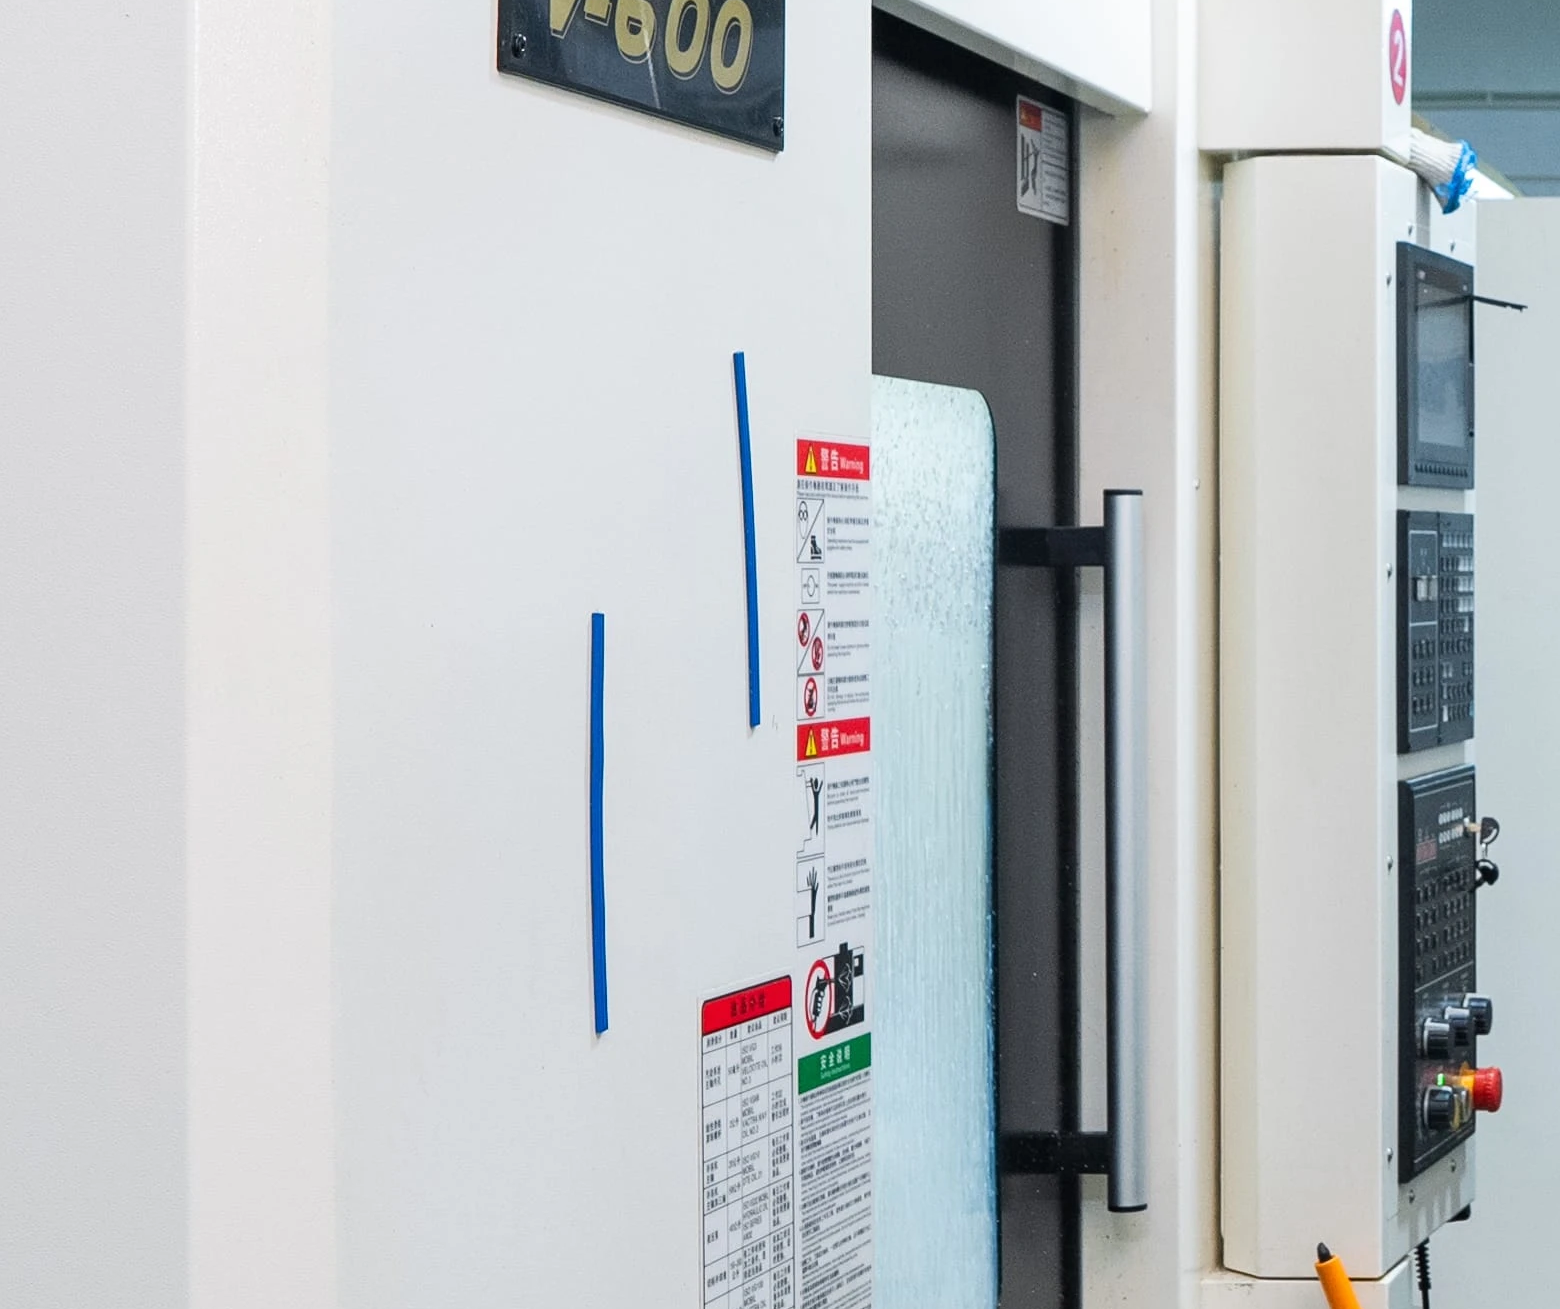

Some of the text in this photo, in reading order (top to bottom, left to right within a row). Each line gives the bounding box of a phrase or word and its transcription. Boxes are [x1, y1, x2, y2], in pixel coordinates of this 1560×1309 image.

[1392, 29, 1404, 85] 2
[840, 457, 864, 474] Warning
[840, 730, 864, 747] Warning
